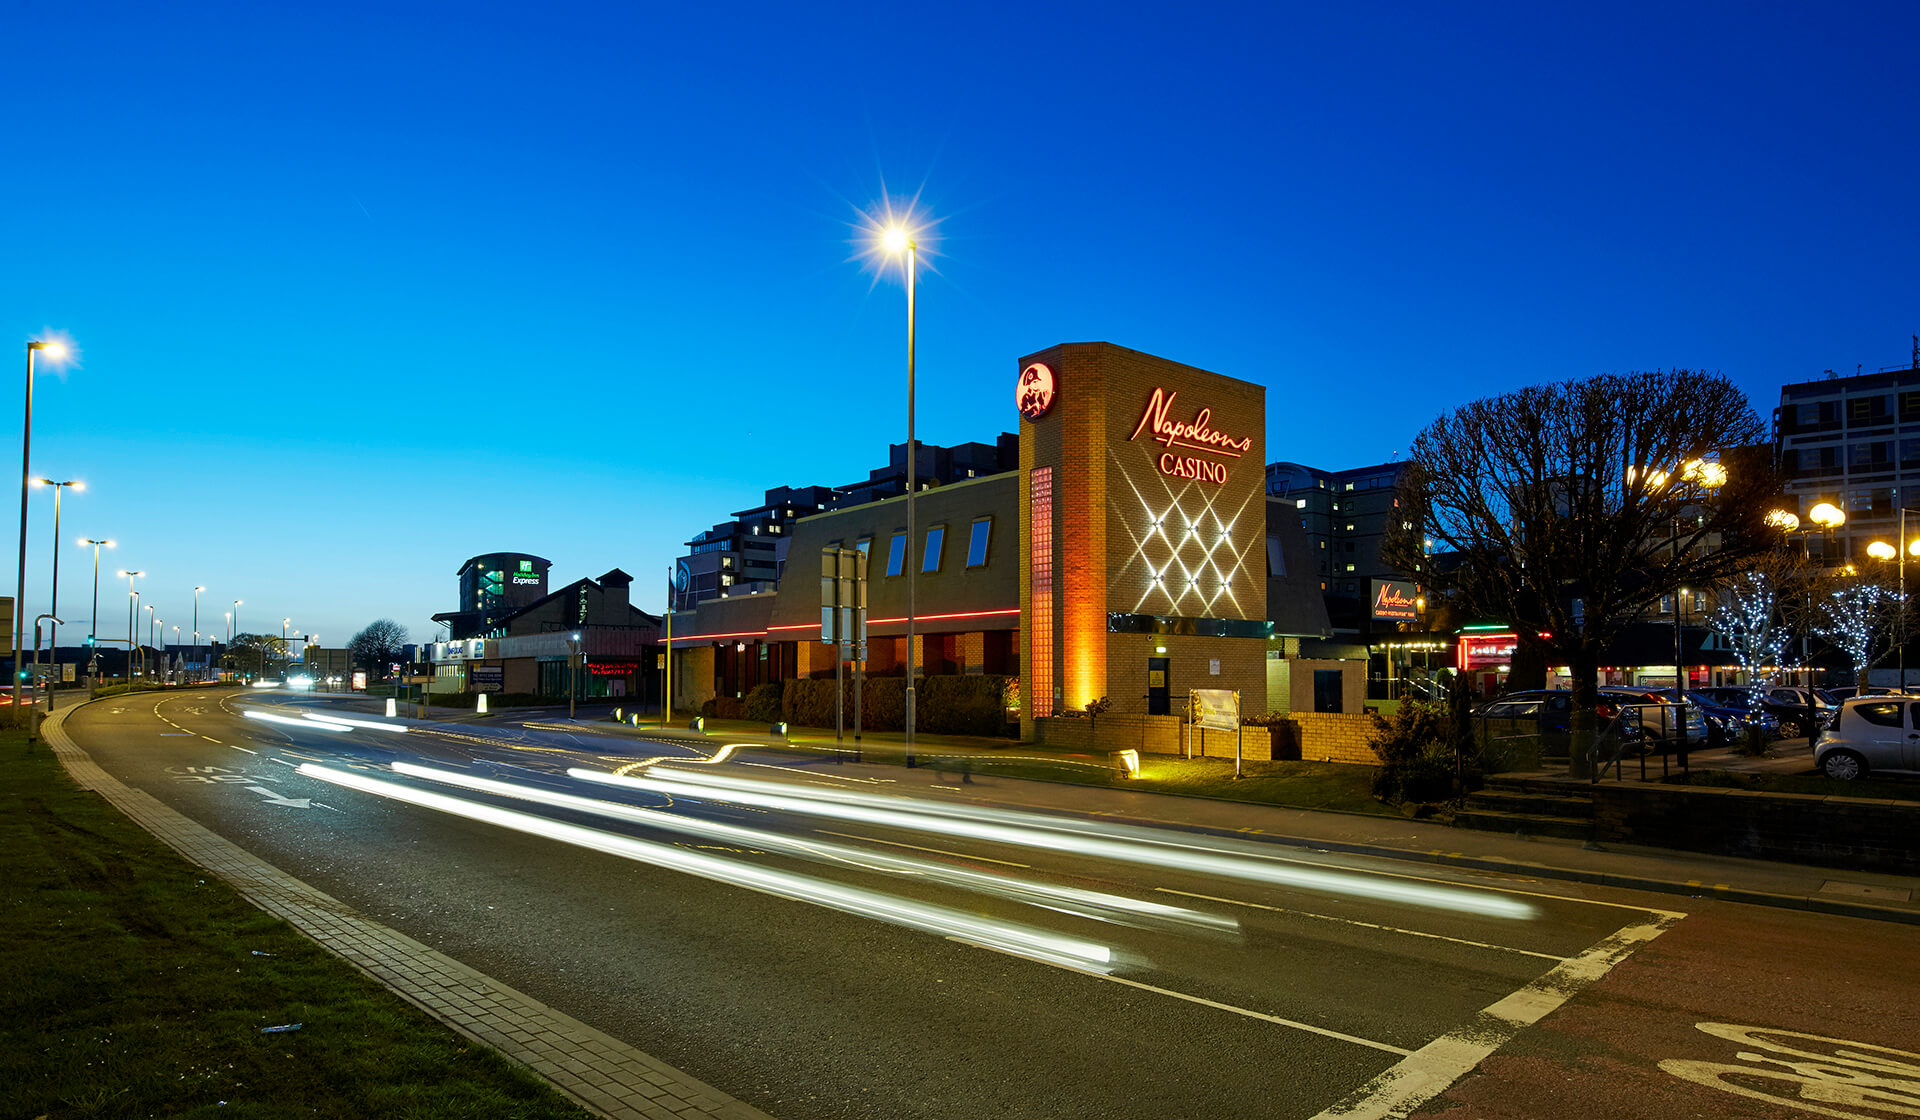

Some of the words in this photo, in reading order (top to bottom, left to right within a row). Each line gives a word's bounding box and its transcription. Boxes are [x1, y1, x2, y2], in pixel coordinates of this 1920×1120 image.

[1130, 387, 1252, 452] Napoleons
[1160, 452, 1228, 485] CASINO
[512, 577, 540, 585] Express
